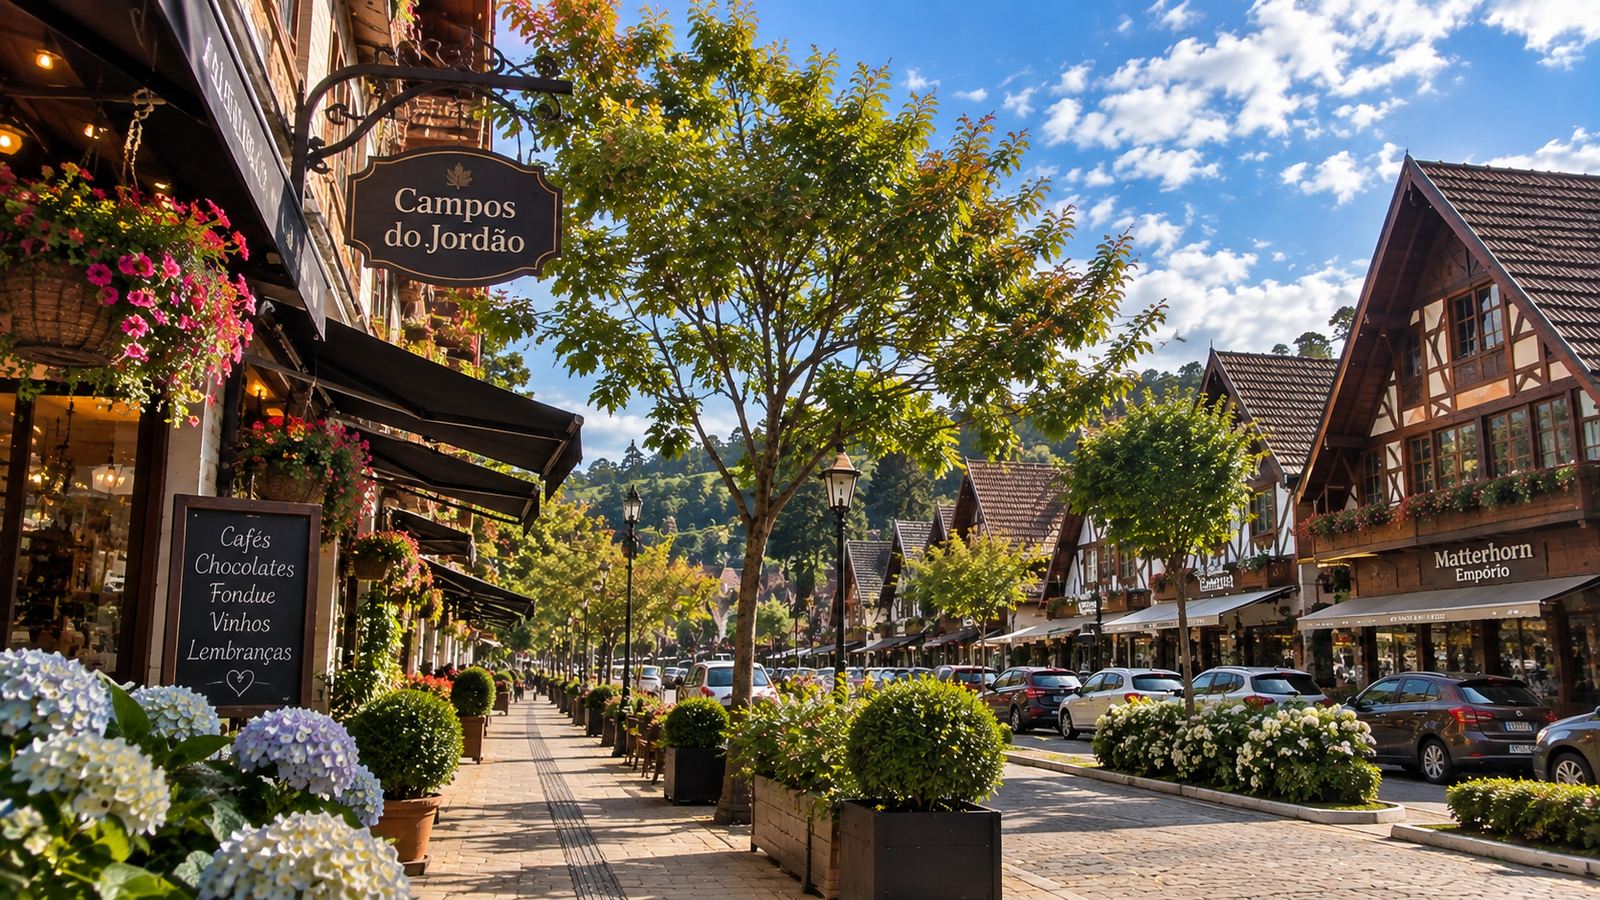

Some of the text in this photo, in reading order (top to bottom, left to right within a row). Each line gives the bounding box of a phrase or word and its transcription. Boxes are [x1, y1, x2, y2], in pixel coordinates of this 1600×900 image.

[394, 187, 517, 223] Campos
[384, 221, 525, 255] do Jordão
[220, 525, 271, 554] Cafés
[194, 553, 295, 578] Chocolates
[1434, 542, 1534, 569] Matterhorn
[209, 582, 276, 605] Fondue
[209, 611, 271, 633] Vinhos
[186, 638, 292, 666] Lembranças
